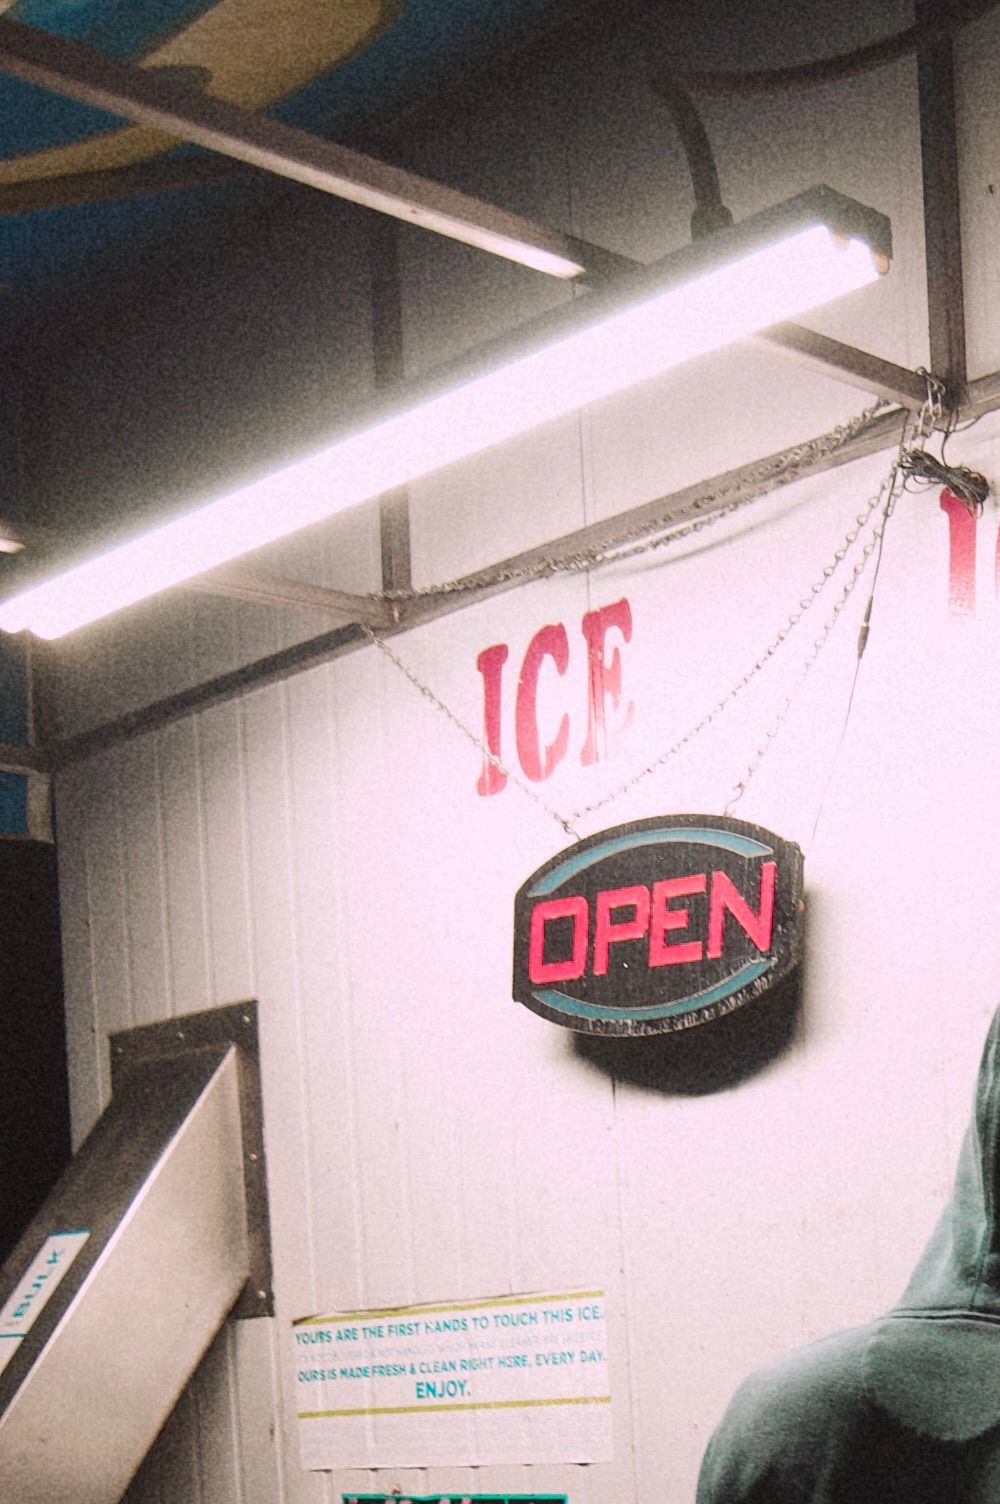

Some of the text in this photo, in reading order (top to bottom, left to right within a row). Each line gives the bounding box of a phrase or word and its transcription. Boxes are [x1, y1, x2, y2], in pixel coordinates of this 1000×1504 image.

[476, 597, 635, 797] ICE
[528, 861, 777, 984] OPEN
[13, 1250, 65, 1318] BULK
[295, 1306, 604, 1345] YOURS ARE THE FIRST HANDS TO TOUCH THIS ICE.
[297, 1369, 325, 1383] OURS
[327, 1368, 337, 1381] IS
[339, 1366, 370, 1379] MADE
[371, 1364, 406, 1377] FRESH
[409, 1363, 416, 1375] &
[419, 1360, 456, 1374] CLEAN
[460, 1357, 494, 1371] RIGHT
[535, 1350, 575, 1366] EVERY
[581, 1349, 607, 1363] DAY.
[416, 1379, 471, 1399] ENJOY.
